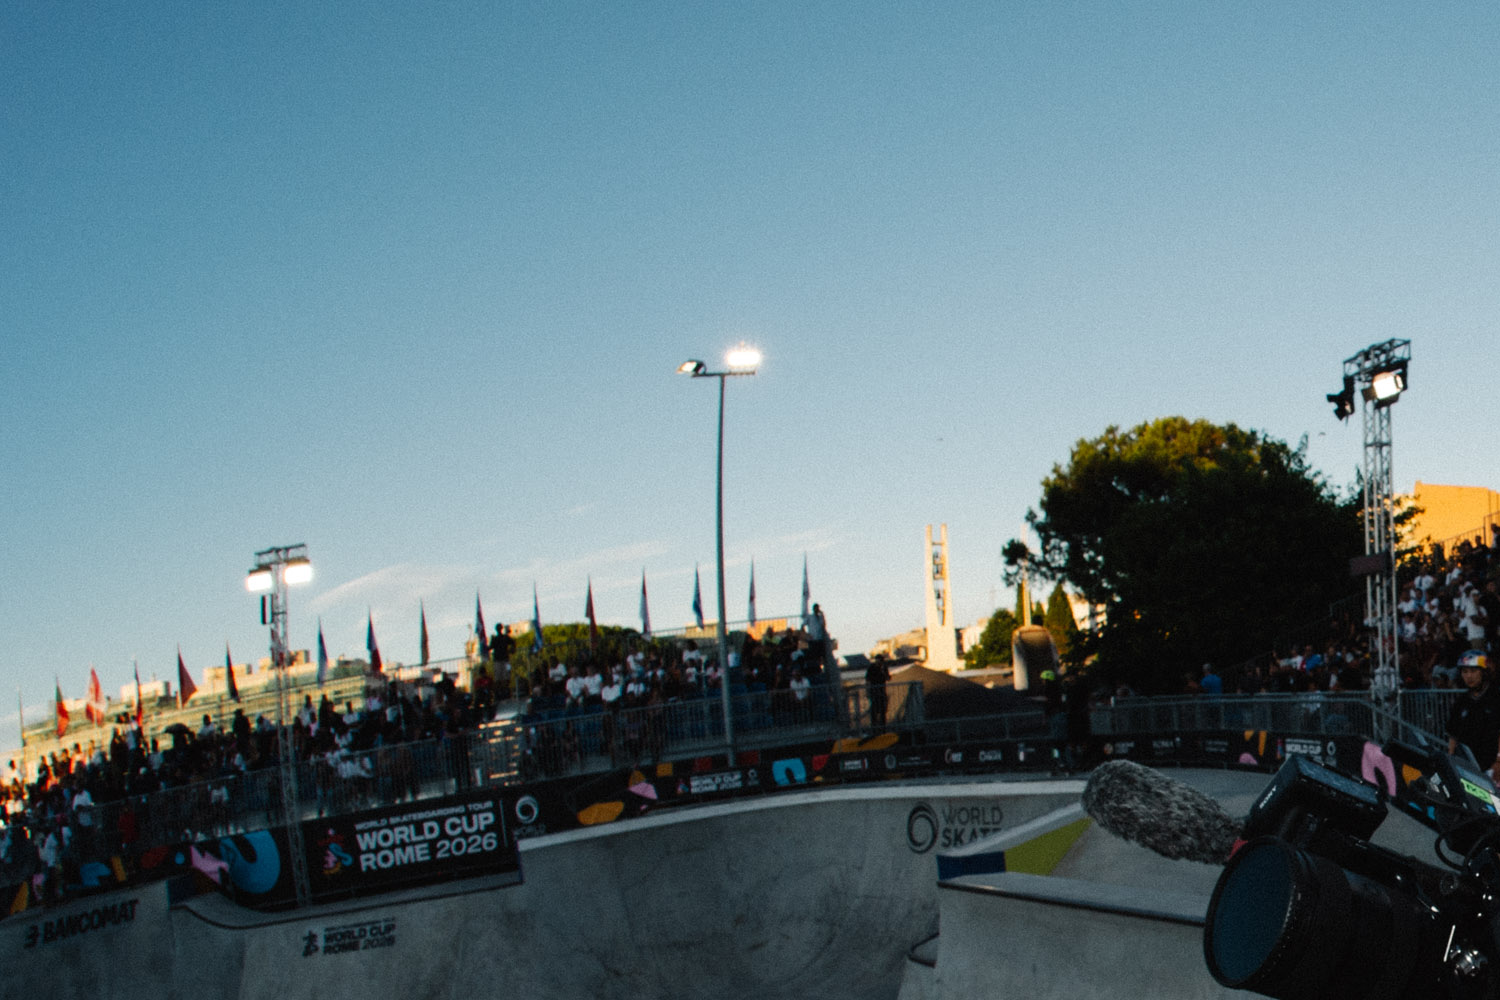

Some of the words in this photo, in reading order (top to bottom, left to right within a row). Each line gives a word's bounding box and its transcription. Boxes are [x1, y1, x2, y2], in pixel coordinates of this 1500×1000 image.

[355, 817, 387, 831] WORLD
[388, 804, 466, 824] SKATEBOARDING
[468, 800, 494, 812] TOUR
[356, 820, 440, 851] WORLD
[444, 811, 495, 837] CUP
[942, 806, 1003, 826] WORLD
[359, 842, 432, 873] ROME
[435, 832, 498, 860] 2026
[43, 899, 139, 945] BANCOMAT
[323, 927, 367, 944] WORLD
[369, 923, 396, 938] CUP
